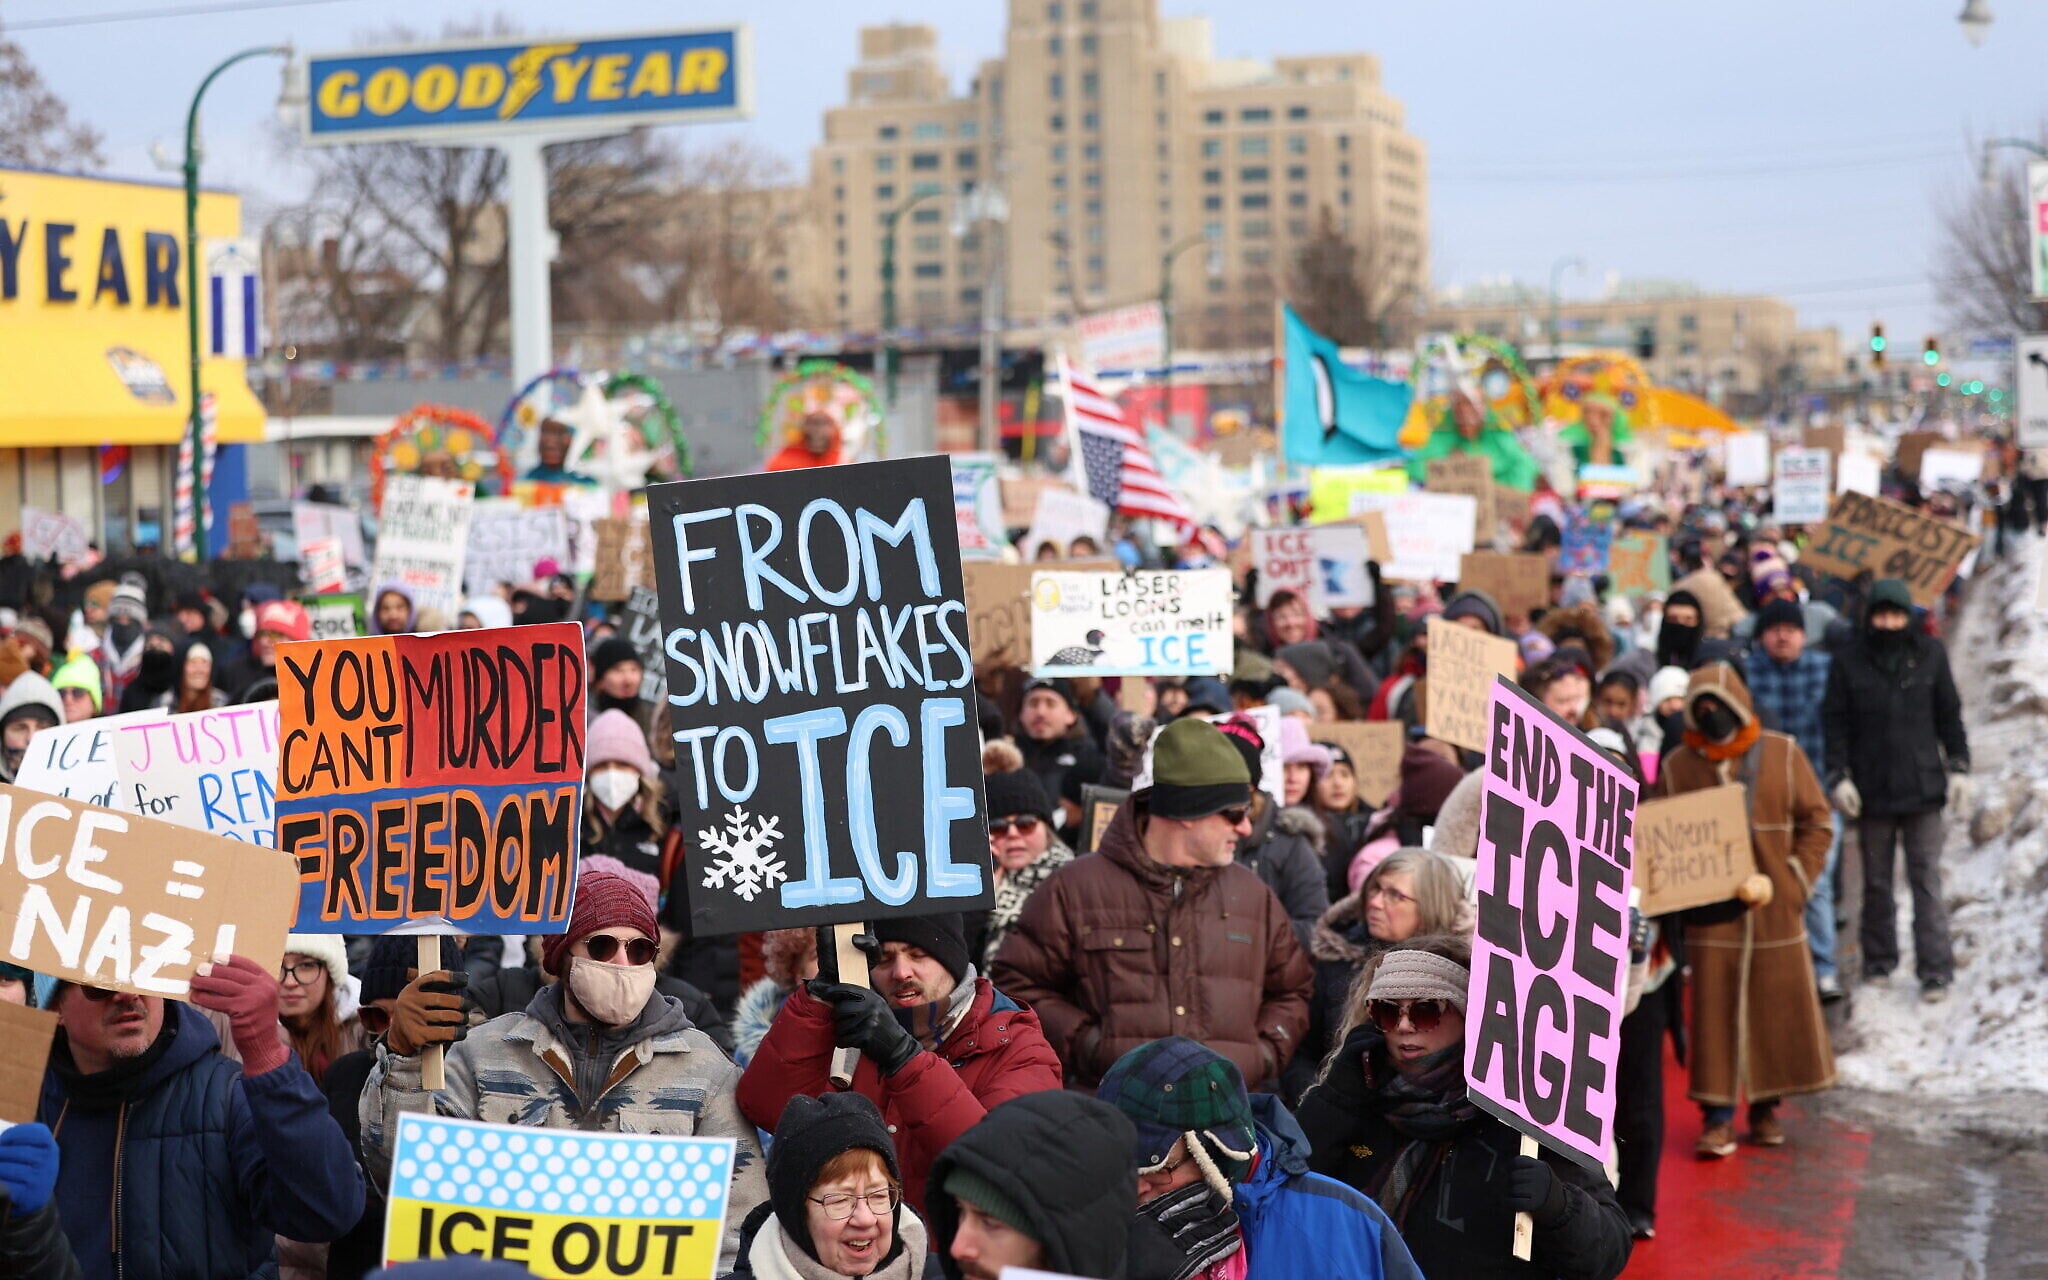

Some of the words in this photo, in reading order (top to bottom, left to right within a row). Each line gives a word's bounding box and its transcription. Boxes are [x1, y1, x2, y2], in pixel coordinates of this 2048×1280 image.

[673, 498, 942, 615] FROM
[1265, 532, 1312, 555] ICE
[1266, 557, 1312, 580] OUT
[1815, 524, 1881, 568] ICE
[1884, 548, 1947, 589] OUT
[1102, 575, 1180, 597] LASER
[1102, 597, 1181, 619] LOONS
[665, 599, 973, 706] SNOWFLAKES
[1130, 618, 1166, 634] can
[1176, 611, 1225, 631] melt
[1138, 633, 1211, 668] ICE
[283, 648, 397, 725] YOU
[402, 643, 583, 777] MURDER
[46, 729, 112, 771] ICE
[120, 708, 280, 772] JUSTI
[282, 724, 403, 794] CANT
[135, 783, 180, 816] for
[673, 724, 759, 810] TO
[764, 697, 983, 908] ICE
[1490, 700, 1562, 808] END
[1570, 752, 1636, 870] THE
[277, 788, 577, 927] FREEDOM
[1477, 790, 1624, 996] ICE
[1471, 951, 1612, 1146] AGE
[418, 1207, 534, 1274] ICE
[552, 1221, 694, 1276] OUT
